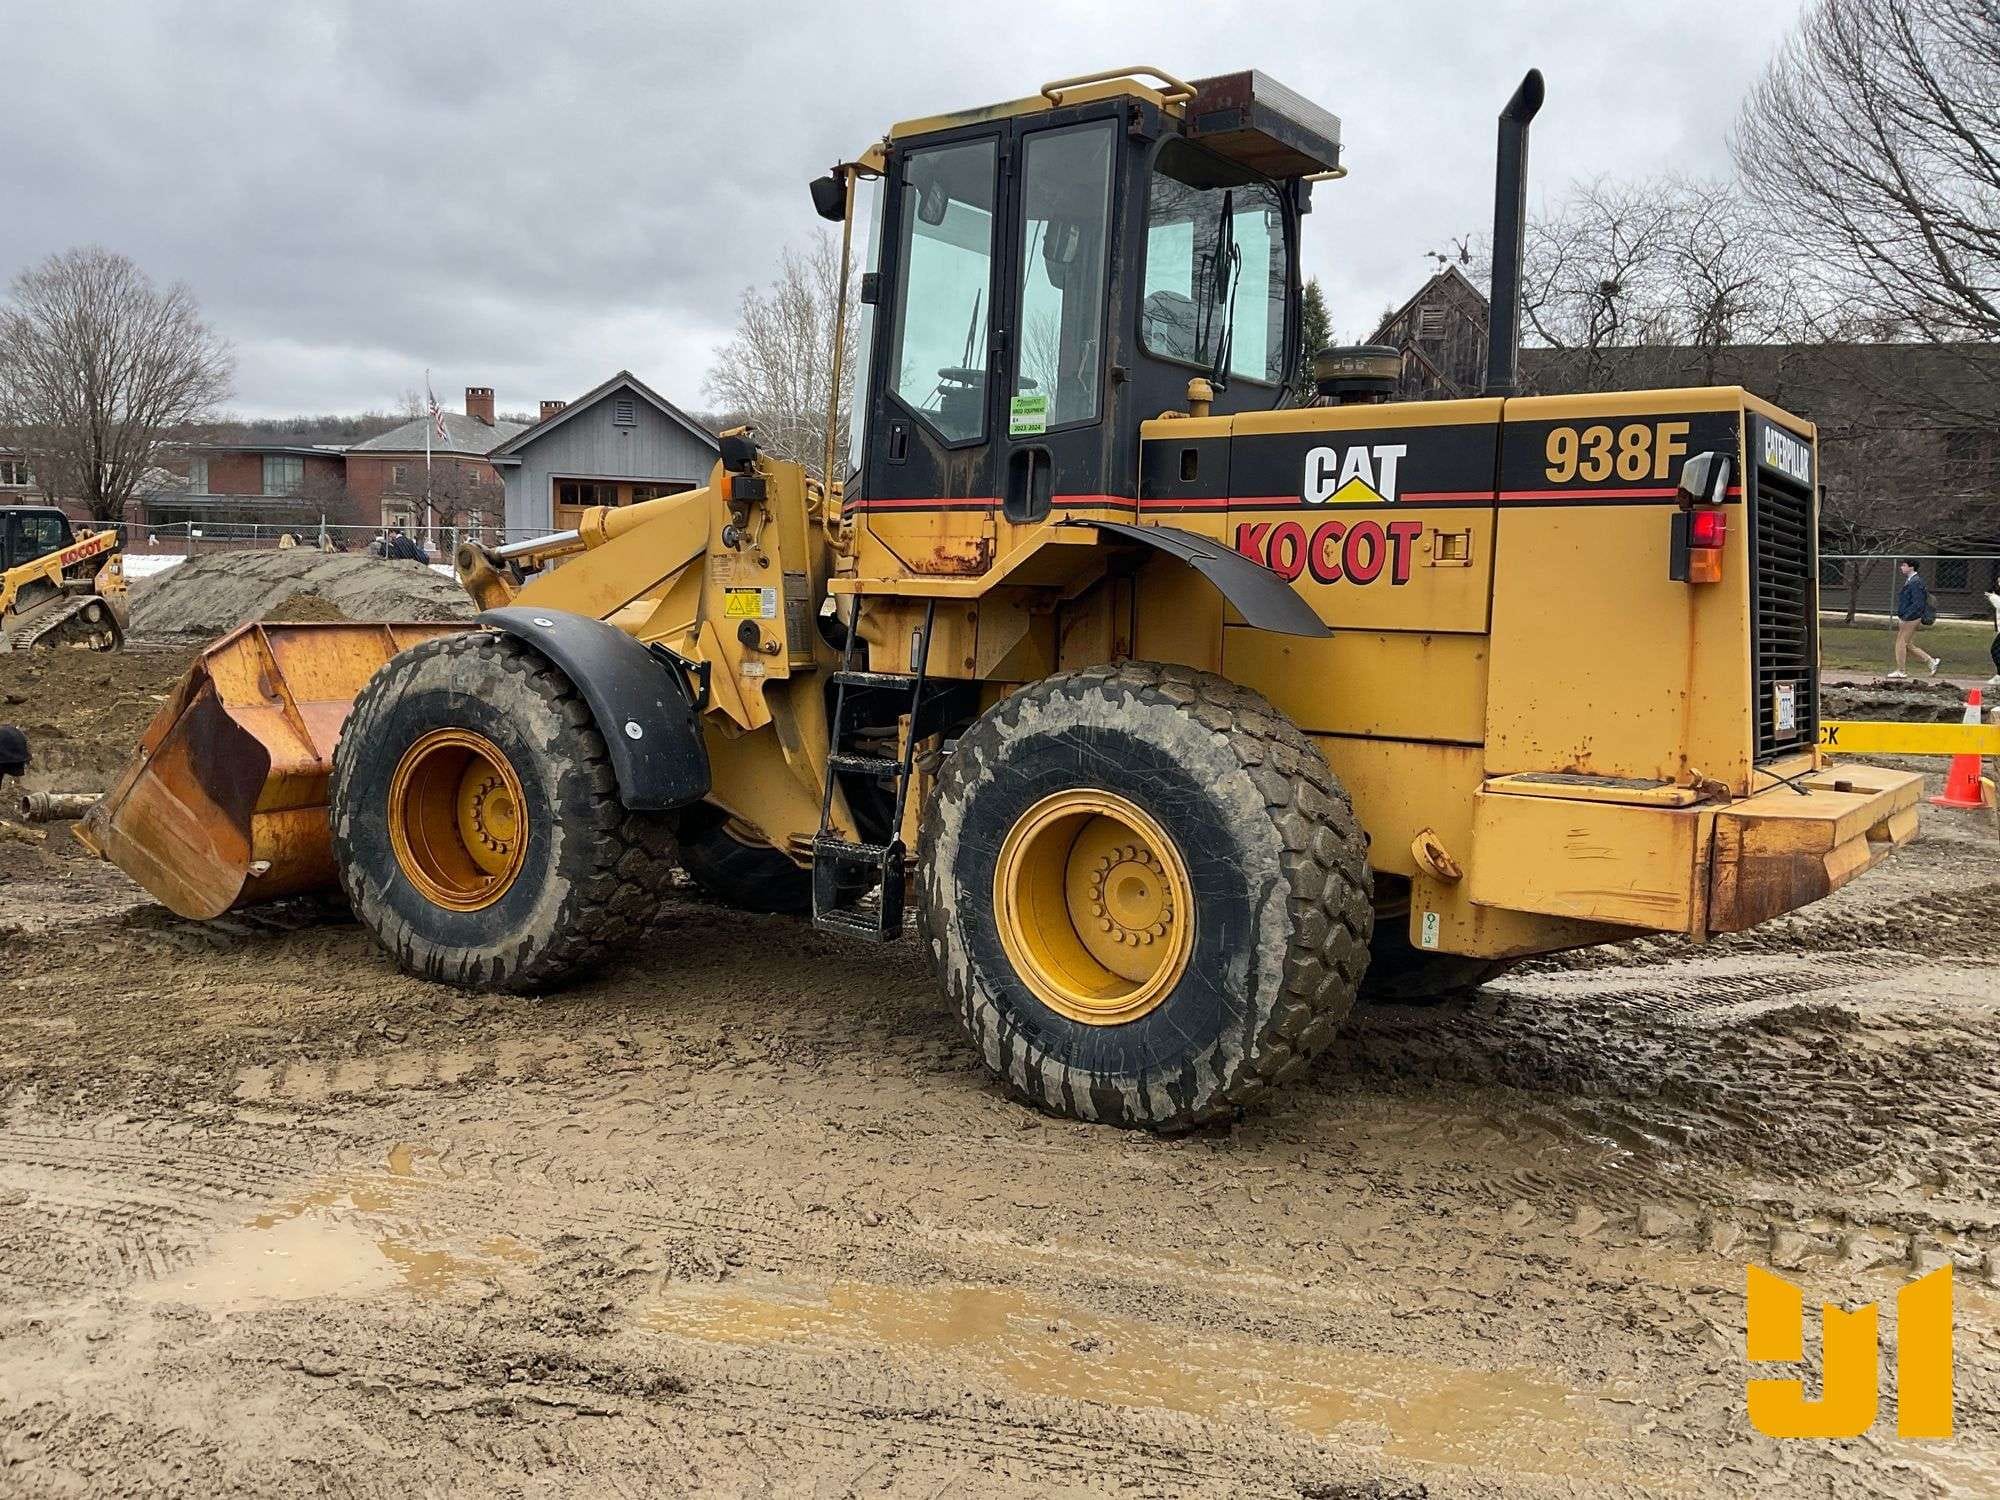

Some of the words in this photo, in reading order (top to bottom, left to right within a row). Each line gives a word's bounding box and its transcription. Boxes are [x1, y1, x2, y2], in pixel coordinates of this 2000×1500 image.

[1304, 444, 1407, 503] CAT
[1545, 421, 1690, 483] 938F
[1765, 425, 1809, 483] CATERPILLAR
[60, 538, 102, 567] KOCOT
[1236, 520, 1422, 586] KOCOT
